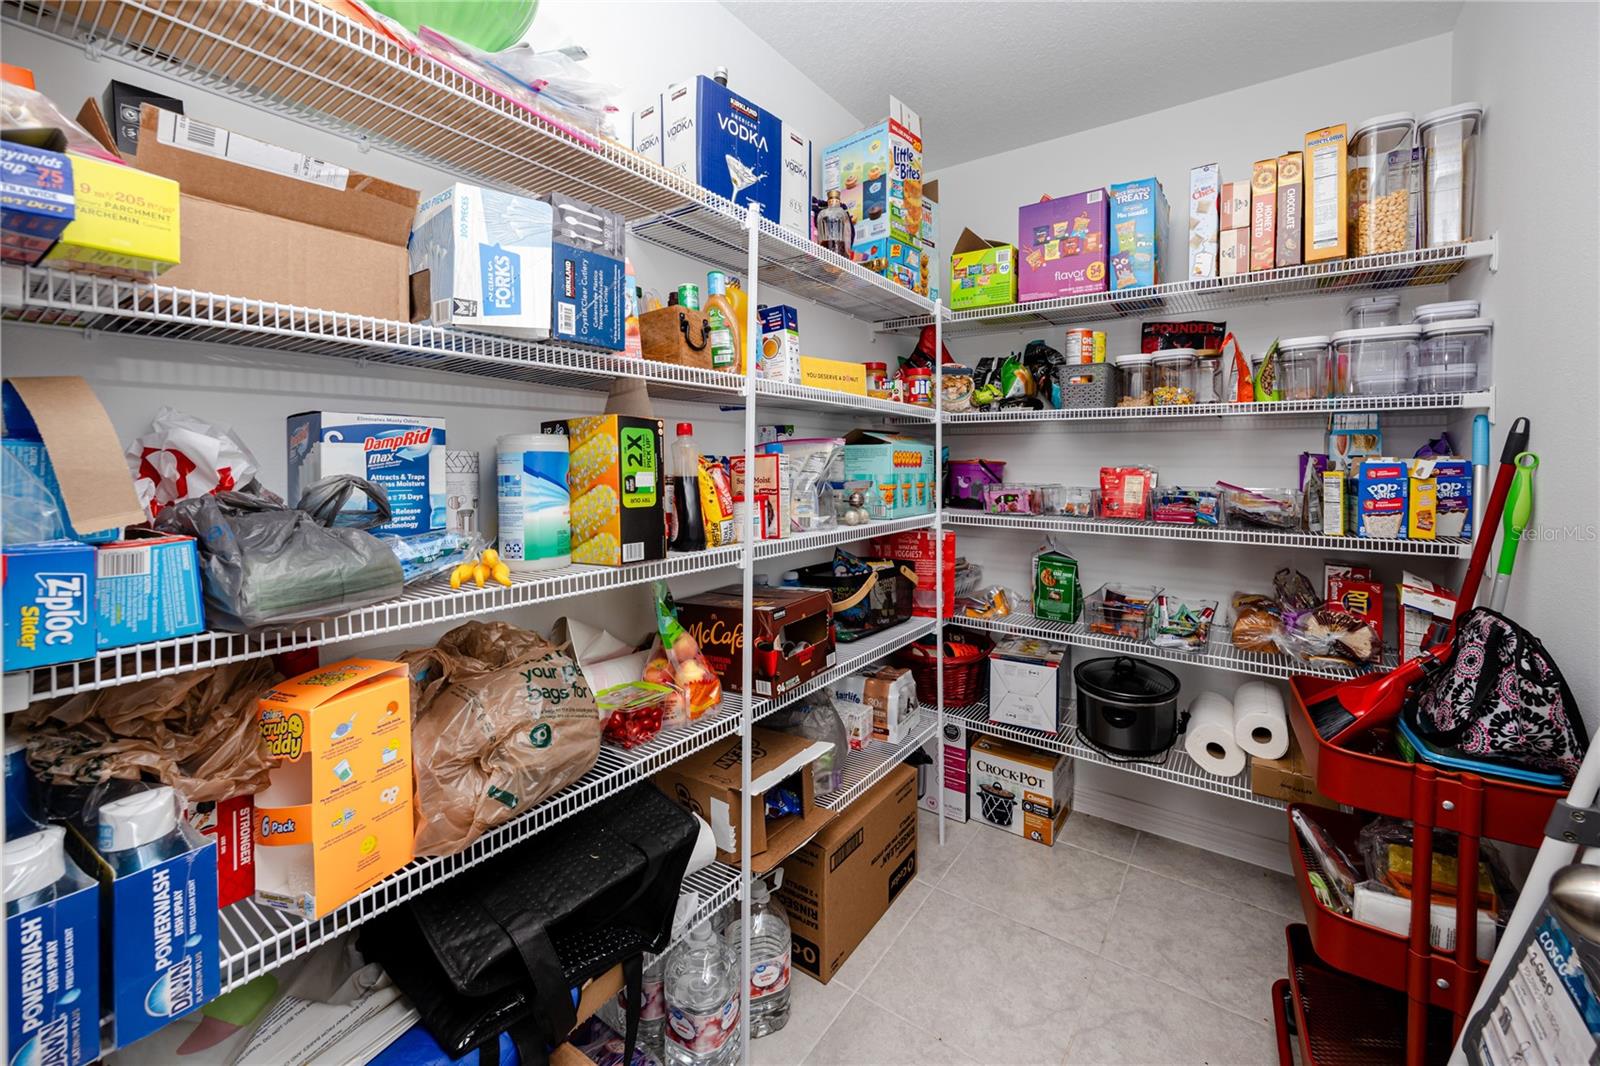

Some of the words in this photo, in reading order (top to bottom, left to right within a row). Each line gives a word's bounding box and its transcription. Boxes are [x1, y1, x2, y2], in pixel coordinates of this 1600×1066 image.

[667, 119, 693, 138] VODKA
[717, 112, 768, 152] VODKA
[0, 148, 64, 169] eynolds
[894, 146, 913, 166] Little
[0, 161, 27, 175] rap
[36, 166, 64, 184] 75
[784, 159, 807, 179] VODKA
[900, 164, 920, 180] Bites
[2, 183, 27, 195] TRA
[115, 191, 146, 208] 205
[1116, 191, 1150, 204] TREATS
[104, 201, 172, 222] PARCHMENT
[460, 196, 468, 222] PIECES
[1264, 204, 1273, 232] HONEY
[1287, 188, 1296, 229] CHOCOLATE
[1256, 202, 1264, 238] ROASTED
[581, 259, 589, 285] Cutlery
[1055, 269, 1085, 281] flavor
[1090, 264, 1102, 275] 54
[494, 255, 512, 309] FORKS
[581, 306, 589, 334] Crystal
[1152, 323, 1214, 334] POUNDER
[818, 372, 838, 382] DESERVE
[912, 380, 931, 396] Jif
[364, 428, 432, 451] DampRid
[627, 434, 642, 467] 2X
[368, 453, 394, 465] max
[408, 474, 425, 482] Traps
[35, 577, 81, 645] Ziploc
[1347, 590, 1369, 615] RITZ
[21, 606, 39, 651] Slider
[688, 621, 744, 655] McCafé
[519, 667, 557, 683] your
[527, 685, 570, 705] bags
[571, 681, 587, 698] for
[776, 684, 786, 695] 94
[836, 690, 861, 704] fairlife
[259, 716, 289, 736] Scrub
[266, 732, 302, 759] addy
[240, 807, 251, 865] STRONGER
[262, 816, 270, 837] 6
[271, 819, 295, 834] Pack
[174, 890, 184, 914] SPRAY
[153, 869, 173, 971] POWERWASH
[174, 915, 184, 937] DISH
[65, 927, 73, 949] SCENT
[46, 940, 58, 969] SPRAY
[65, 950, 73, 971] CLEAN
[1539, 931, 1570, 977] COSCO
[21, 917, 44, 1034] POWERWASH
[46, 970, 58, 993] DISH
[65, 971, 73, 990] FRESH
[169, 955, 193, 1018] DAWN
